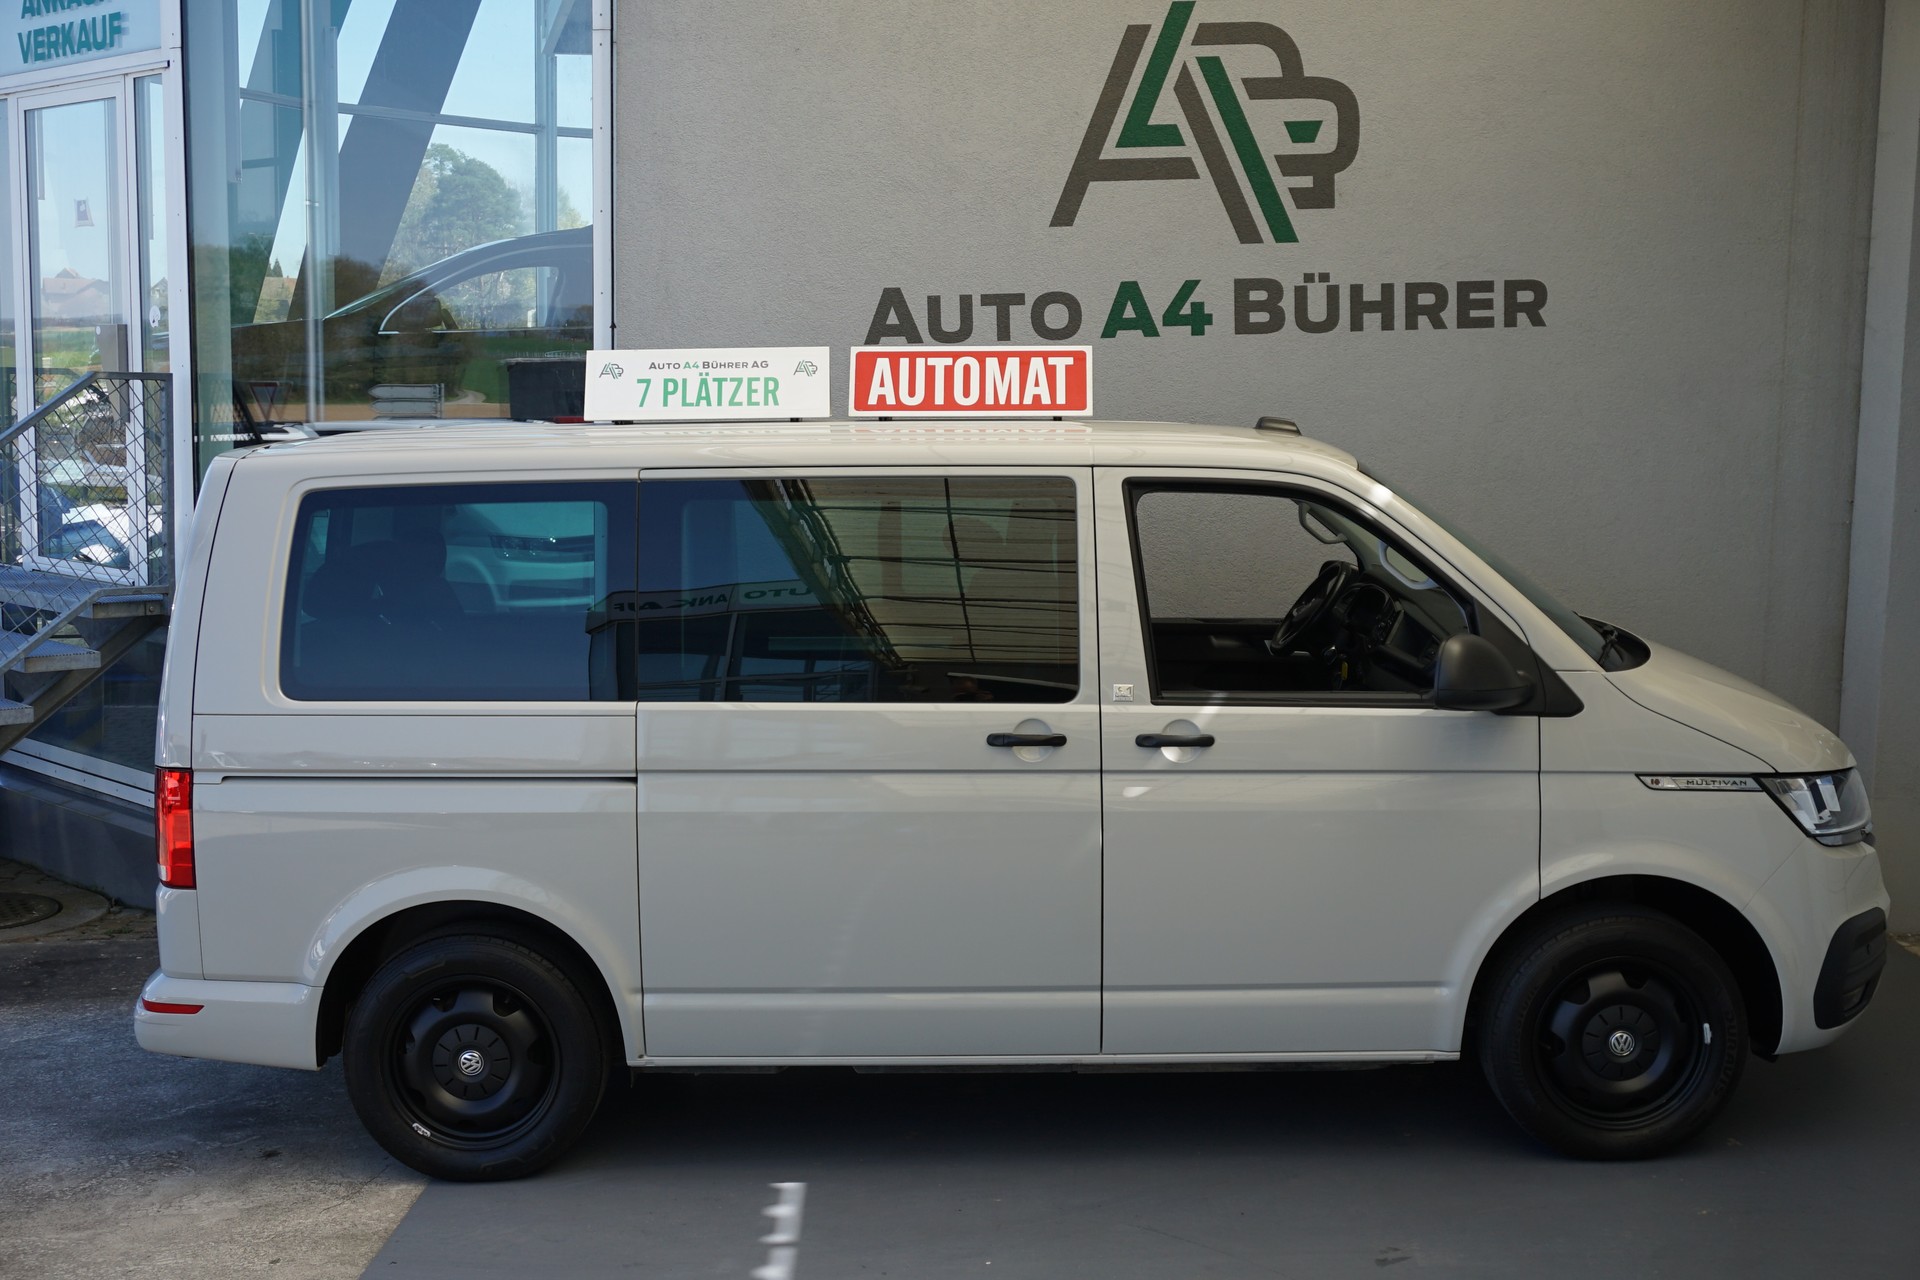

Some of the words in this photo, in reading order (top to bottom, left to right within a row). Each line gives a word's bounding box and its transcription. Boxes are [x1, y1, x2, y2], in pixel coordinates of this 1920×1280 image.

[17, 11, 122, 64] VERKAUF
[864, 287, 1082, 346] AUTO
[1100, 280, 1214, 339] A4
[1233, 272, 1548, 335] BÜHRER
[636, 378, 652, 408] 7
[662, 372, 780, 408] PLÄTZER
[648, 361, 681, 371] AUTO
[682, 361, 700, 370] A4
[702, 360, 749, 370] BÜHRER
[751, 360, 769, 369] AG
[867, 356, 1074, 406] AUTOMAT
